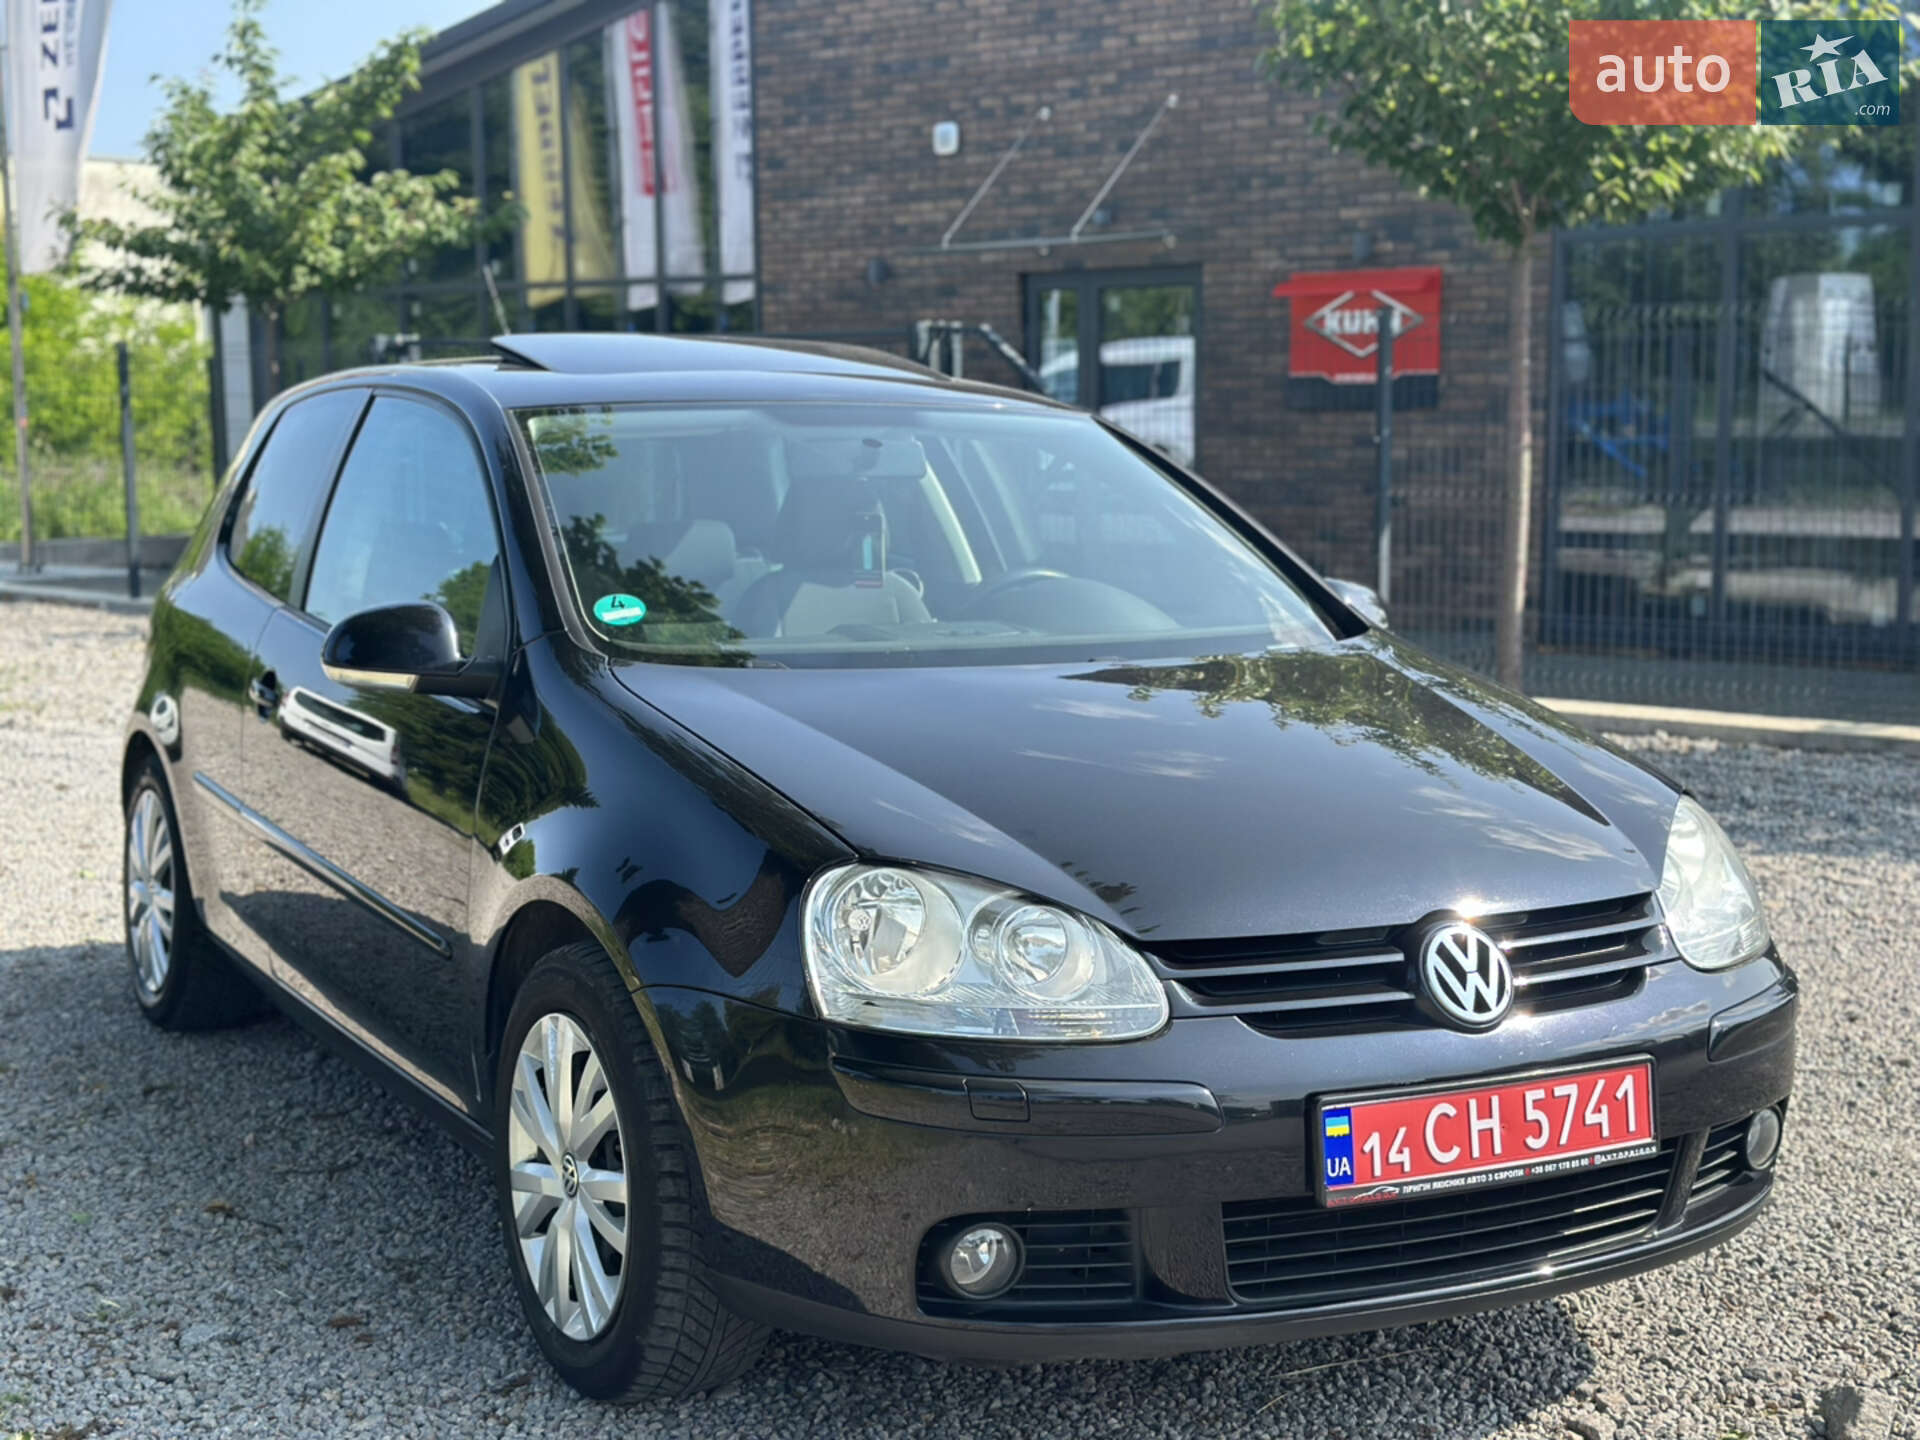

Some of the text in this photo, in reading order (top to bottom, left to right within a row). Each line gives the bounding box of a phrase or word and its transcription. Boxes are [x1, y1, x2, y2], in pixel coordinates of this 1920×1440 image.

[1426, 922, 1513, 1023] VW
[1327, 1157, 1351, 1178] UA
[1362, 1074, 1637, 1177] 14 CH 5741
